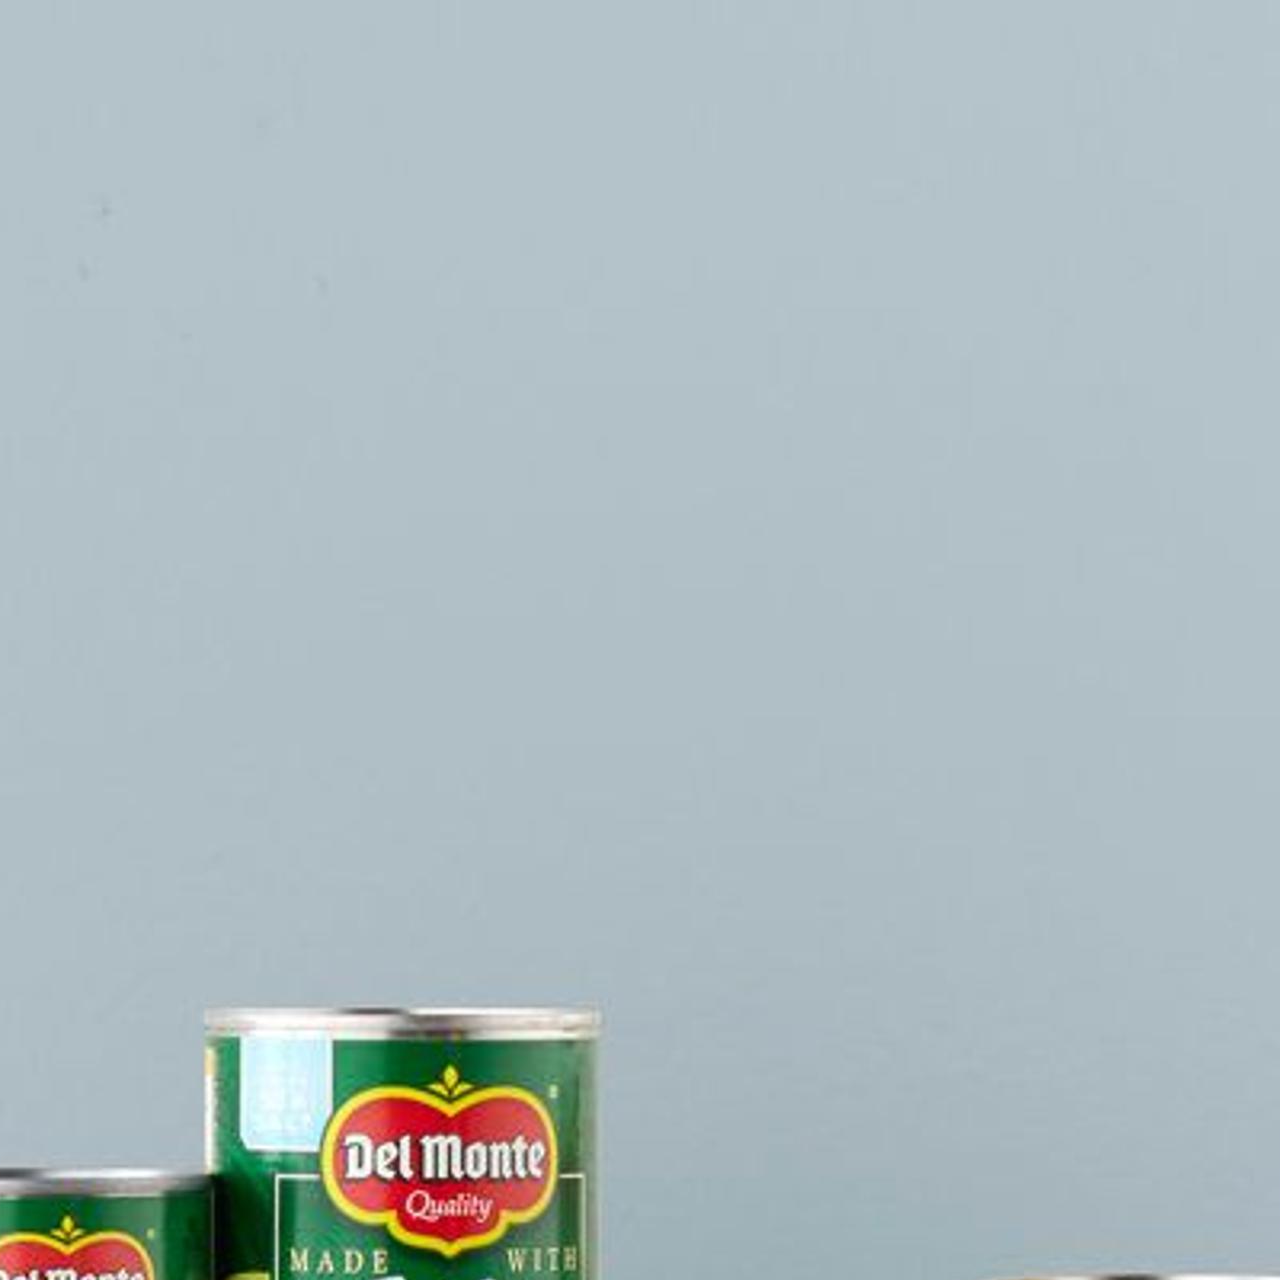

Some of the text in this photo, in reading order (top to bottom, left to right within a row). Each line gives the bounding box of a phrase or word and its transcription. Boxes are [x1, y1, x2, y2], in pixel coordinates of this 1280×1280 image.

[344, 1133, 546, 1180] Del Monte
[405, 1189, 493, 1222] Quality
[290, 1247, 578, 1275] MADE WITH
